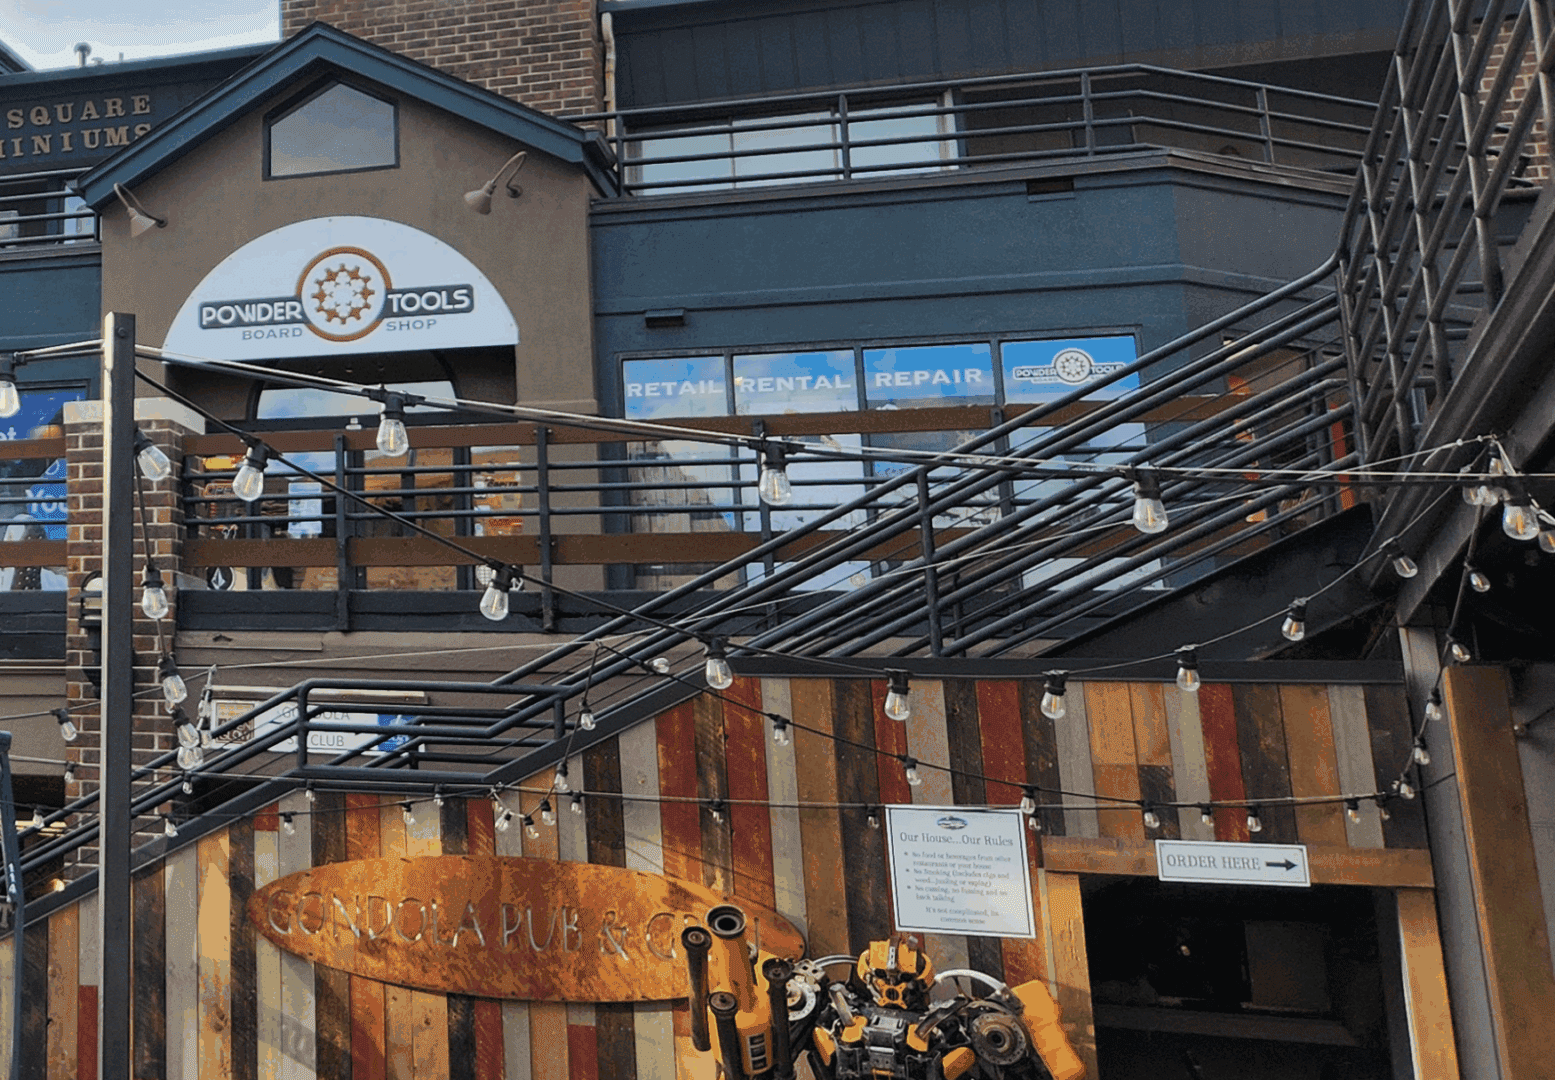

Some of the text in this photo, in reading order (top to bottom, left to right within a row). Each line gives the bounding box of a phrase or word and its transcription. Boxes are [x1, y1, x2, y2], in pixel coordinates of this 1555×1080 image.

[6, 94, 151, 129] SQUARE
[201, 288, 471, 325] POWDER TOOLS
[242, 319, 437, 341] BOARD SHOP
[875, 368, 982, 387] REPAIR
[1016, 368, 1057, 377] POWDER
[627, 379, 723, 397] RETAIL
[739, 374, 851, 393] RENTAL
[282, 707, 350, 721] GOLA
[311, 734, 345, 747] CLUB
[900, 831, 919, 842] Our
[984, 835, 1014, 846] Rules
[1166, 854, 1261, 871] ORDER HERE
[267, 888, 488, 949] GONDOLA
[501, 902, 583, 953] PUB
[599, 910, 630, 961] &
